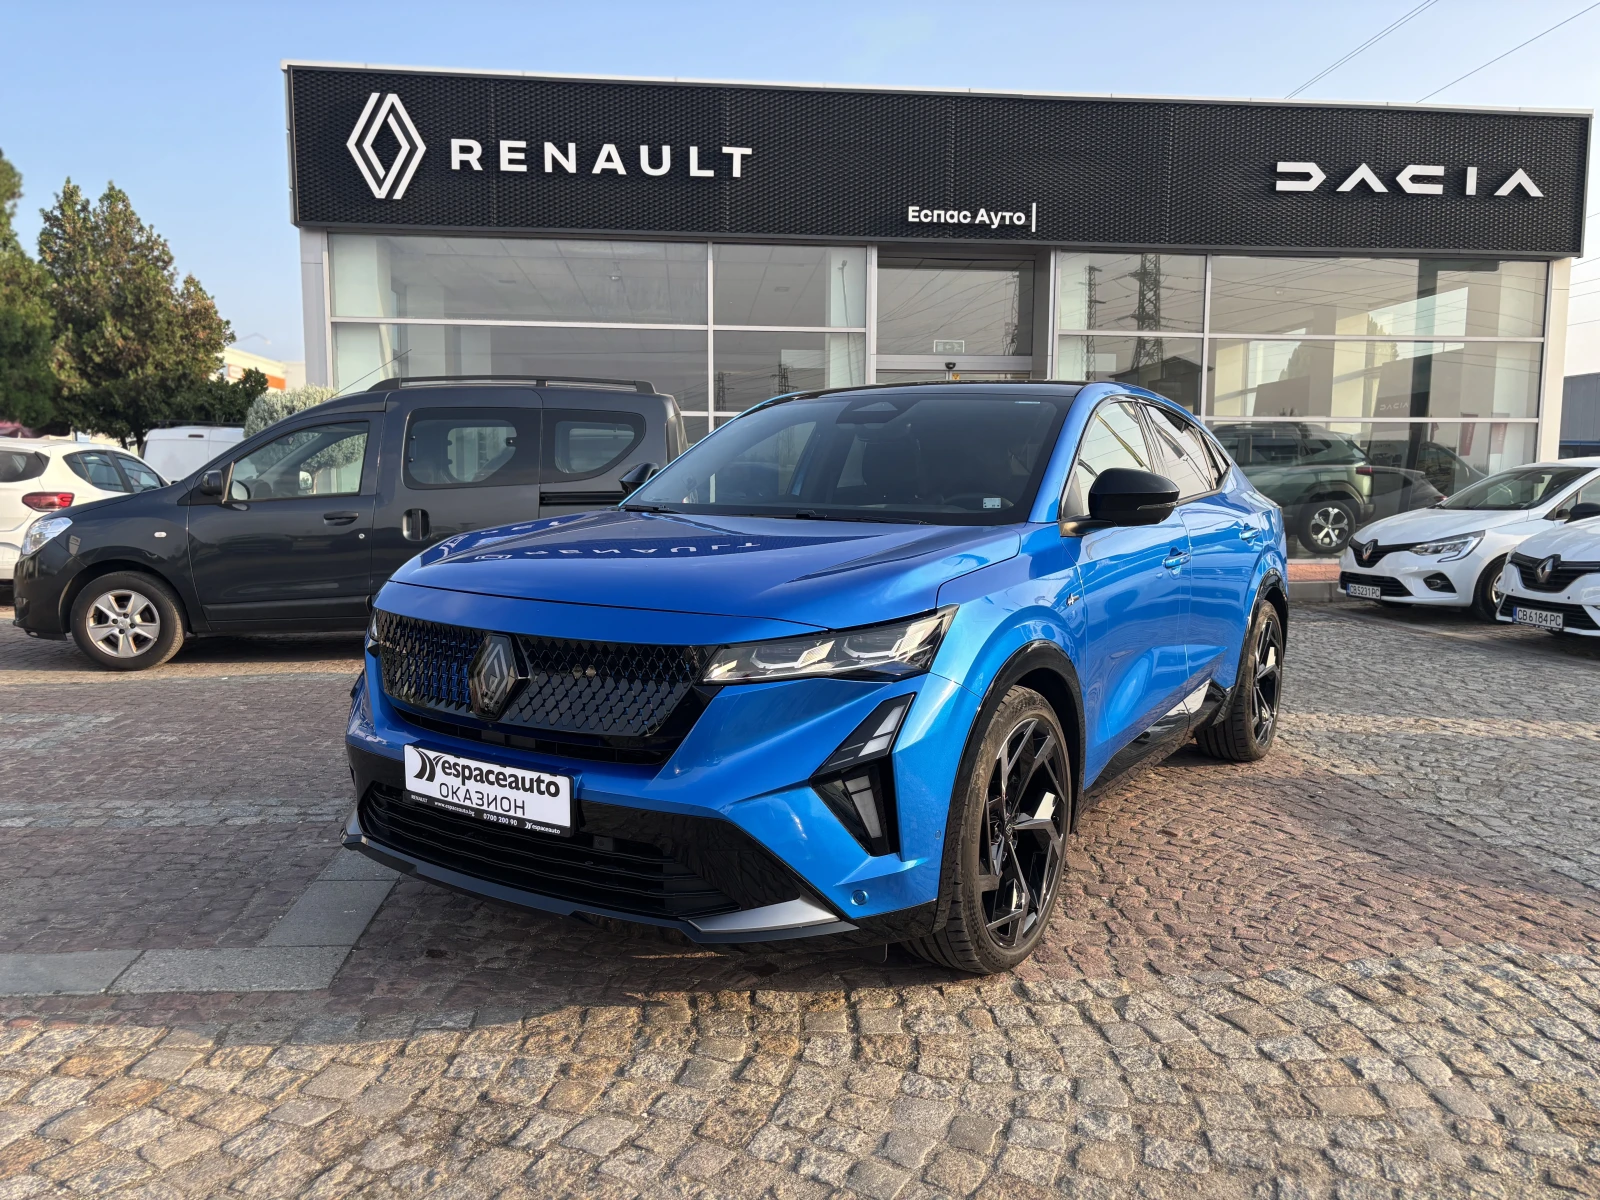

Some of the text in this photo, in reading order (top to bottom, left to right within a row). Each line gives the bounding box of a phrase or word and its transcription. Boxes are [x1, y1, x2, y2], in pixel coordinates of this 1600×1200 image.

[450, 138, 752, 178] RENAULT
[1276, 162, 1544, 197] DACIA
[908, 206, 1026, 229] Еспас Ауто
[1380, 402, 1409, 411] DACIA
[1529, 611, 1548, 624] 6184
[441, 759, 560, 797] espaceauto
[434, 801, 475, 817] www.espaceauto.bg
[439, 783, 526, 816] ОКАЗИОН
